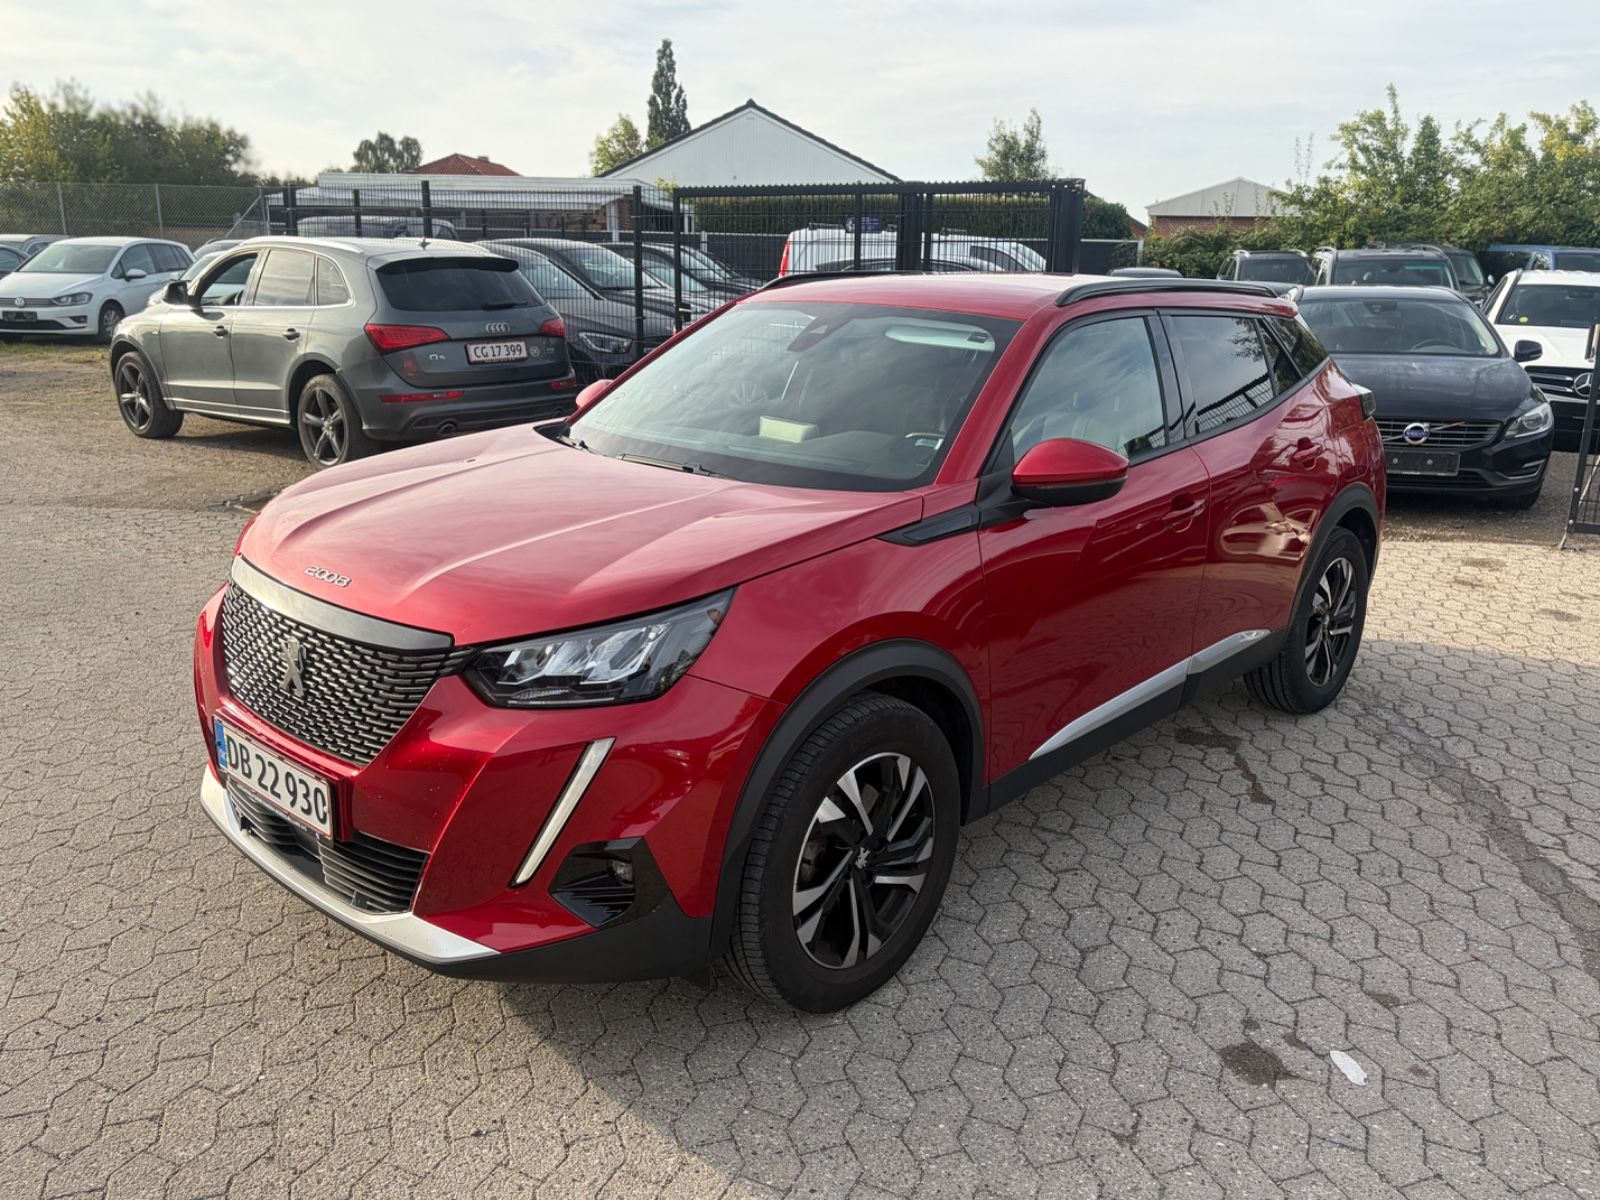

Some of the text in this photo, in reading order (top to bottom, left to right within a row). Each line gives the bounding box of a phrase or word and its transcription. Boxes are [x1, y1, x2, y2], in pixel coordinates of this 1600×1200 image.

[473, 343, 522, 359] CG 17 399
[304, 565, 351, 587] 2008
[226, 734, 252, 779] DB
[255, 753, 281, 800] 22
[285, 771, 328, 825] 930
